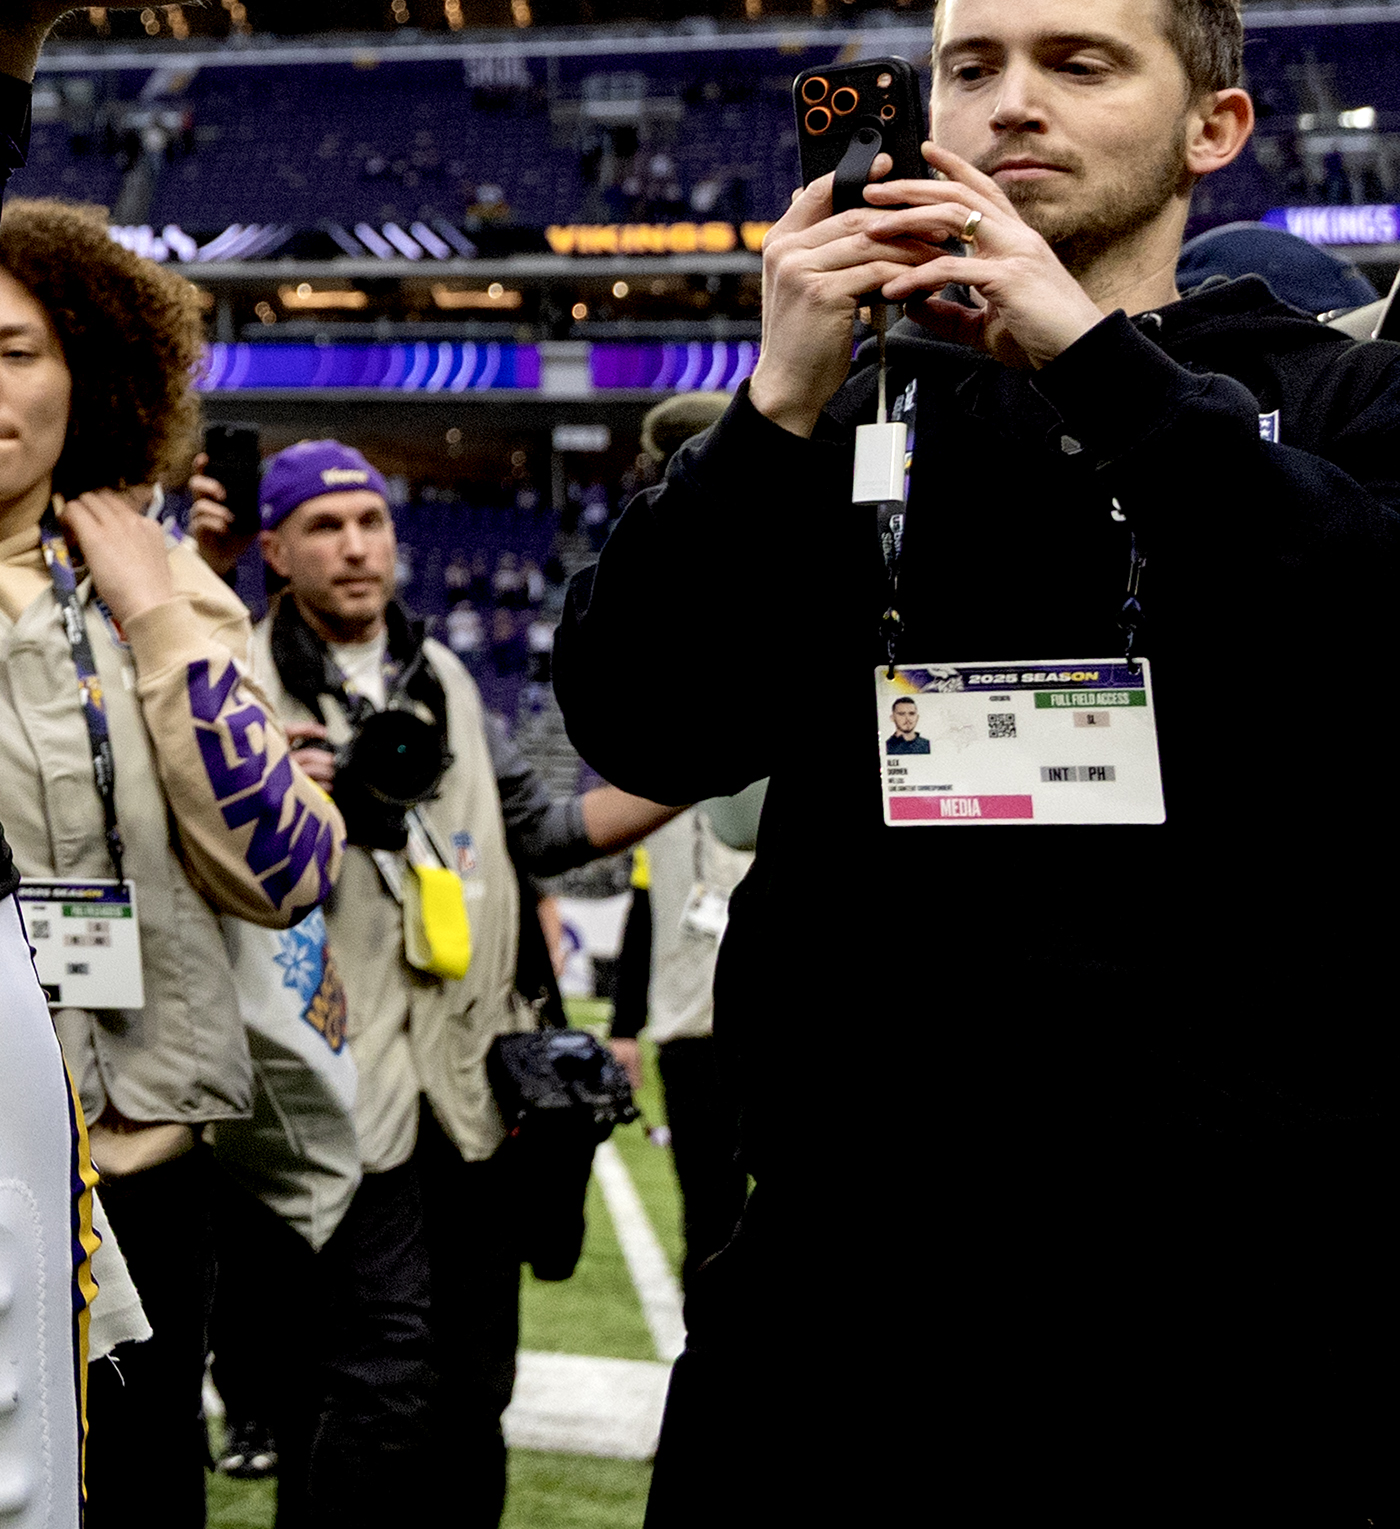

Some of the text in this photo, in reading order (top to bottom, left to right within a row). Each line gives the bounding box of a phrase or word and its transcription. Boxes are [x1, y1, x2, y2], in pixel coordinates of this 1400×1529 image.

[967, 671, 1099, 685] 2025 SEASON
[1051, 692, 1130, 706] FULL FIELD ACCESS
[1049, 767, 1106, 781] INT PH
[940, 798, 982, 817] MEDIA
